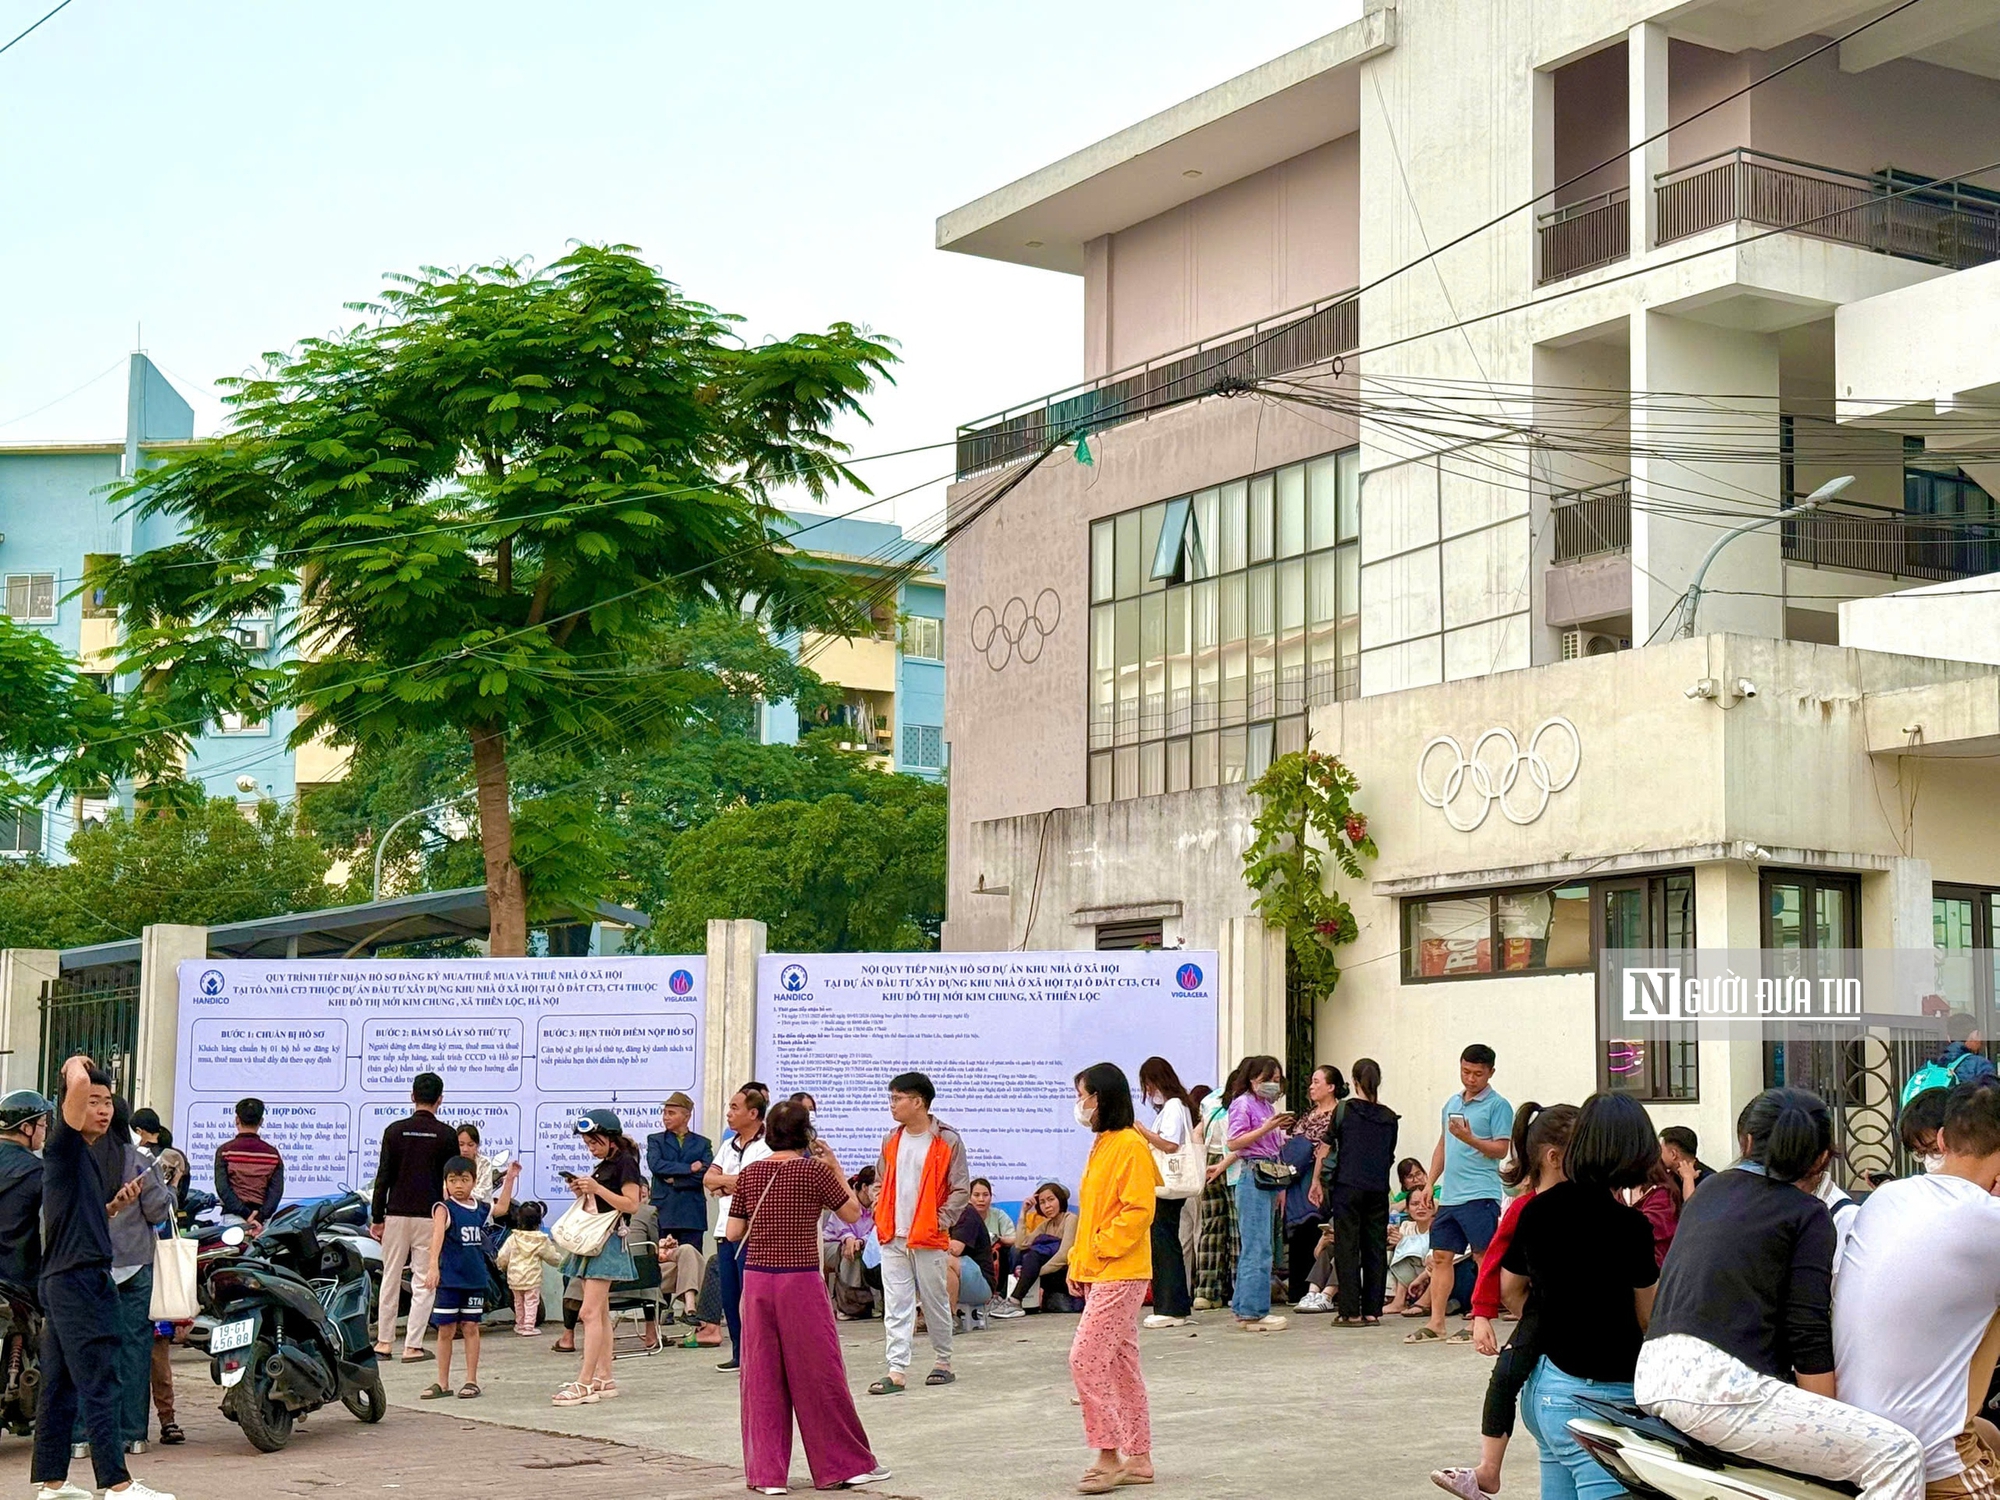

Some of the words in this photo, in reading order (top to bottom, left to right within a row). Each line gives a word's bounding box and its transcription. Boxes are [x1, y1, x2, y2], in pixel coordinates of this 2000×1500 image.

[861, 965, 880, 975] NỘI
[882, 966, 906, 975] QUY
[906, 964, 928, 974] TIẾP
[928, 964, 957, 975] NHẬN
[960, 963, 974, 974] HỒ
[977, 966, 990, 974] SƠ
[992, 964, 1008, 975] DỰ
[1009, 963, 1023, 973] ÁN
[1026, 965, 1048, 973] KHU
[1050, 963, 1071, 973] NHÀ
[1074, 963, 1082, 973] Ở
[1084, 963, 1098, 973] XÃ
[1100, 964, 1120, 975] HỘI
[266, 974, 285, 982] QUY
[286, 972, 316, 981] TRÌNH
[318, 972, 339, 981] TIẾP
[340, 973, 366, 982] NHẬN
[368, 972, 382, 981] HỒ
[384, 973, 398, 981] SƠ
[399, 972, 425, 981] ĐĂNG
[427, 971, 441, 980] KÝ
[442, 971, 492, 980] MUA/THUÊ
[494, 972, 515, 980] MUA
[516, 971, 530, 980] VÀ
[530, 970, 557, 980] THUÊ
[558, 970, 579, 979] NHÀ
[580, 970, 588, 979] Ở
[590, 970, 603, 979] XÃ
[605, 970, 623, 980] HỘI
[824, 979, 841, 988] TẠI
[843, 978, 858, 988] DỰ
[860, 977, 874, 987] ÁN
[876, 977, 897, 987] ĐẦU
[899, 978, 914, 987] TƯ
[916, 977, 937, 987] XÂY
[938, 978, 968, 988] DỰNG
[970, 979, 992, 987] KHU
[994, 977, 1015, 987] NHÀ
[1018, 977, 1026, 987] Ở
[1028, 977, 1042, 987] XÃ
[1044, 978, 1064, 988] HỘI
[1065, 979, 1083, 988] TẠI
[1085, 977, 1093, 987] Ô
[1095, 977, 1116, 986] ĐẤT
[1118, 978, 1140, 987] CT3,
[1141, 978, 1160, 986] CT4
[232, 986, 248, 995] TẠI
[270, 985, 289, 994] NHÀ
[309, 986, 342, 995] THUỘC
[342, 985, 356, 995] DỰ
[358, 984, 370, 994] ÁN
[372, 984, 391, 994] ĐẦU
[392, 984, 406, 994] TƯ
[406, 984, 426, 993] XÂY
[428, 985, 454, 994] DỰNG
[476, 983, 496, 993] NHÀ
[498, 983, 505, 993] Ở
[506, 984, 520, 993] XÃ
[521, 984, 538, 994] HỘI
[540, 985, 555, 994] TẠI
[557, 983, 565, 992] Ô
[566, 983, 586, 992] ĐẤT
[586, 984, 606, 992] CT3,
[626, 983, 658, 992] THUỘC
[349, 997, 363, 1006] ĐÔ
[364, 999, 380, 1007] THỊ
[382, 997, 401, 1006] MỚI
[402, 998, 420, 1006] KIM
[460, 997, 474, 1005] XÃ
[476, 996, 503, 1005] THIÊN
[504, 997, 527, 1006] LỘC,
[528, 996, 541, 1005] HÀ
[543, 997, 560, 1006] NỘI
[882, 993, 904, 1001] KHU
[906, 991, 921, 1001] ĐÔ
[923, 993, 940, 1003] THỊ
[942, 991, 963, 1001] MỚI
[966, 993, 986, 1001] KIM
[988, 993, 1027, 1001] CHUNG,
[1029, 991, 1044, 1001] XÃ
[1045, 991, 1077, 1001] THIÊN
[1079, 991, 1101, 1002] LỘC
[219, 1322, 246, 1338] 19-G1
